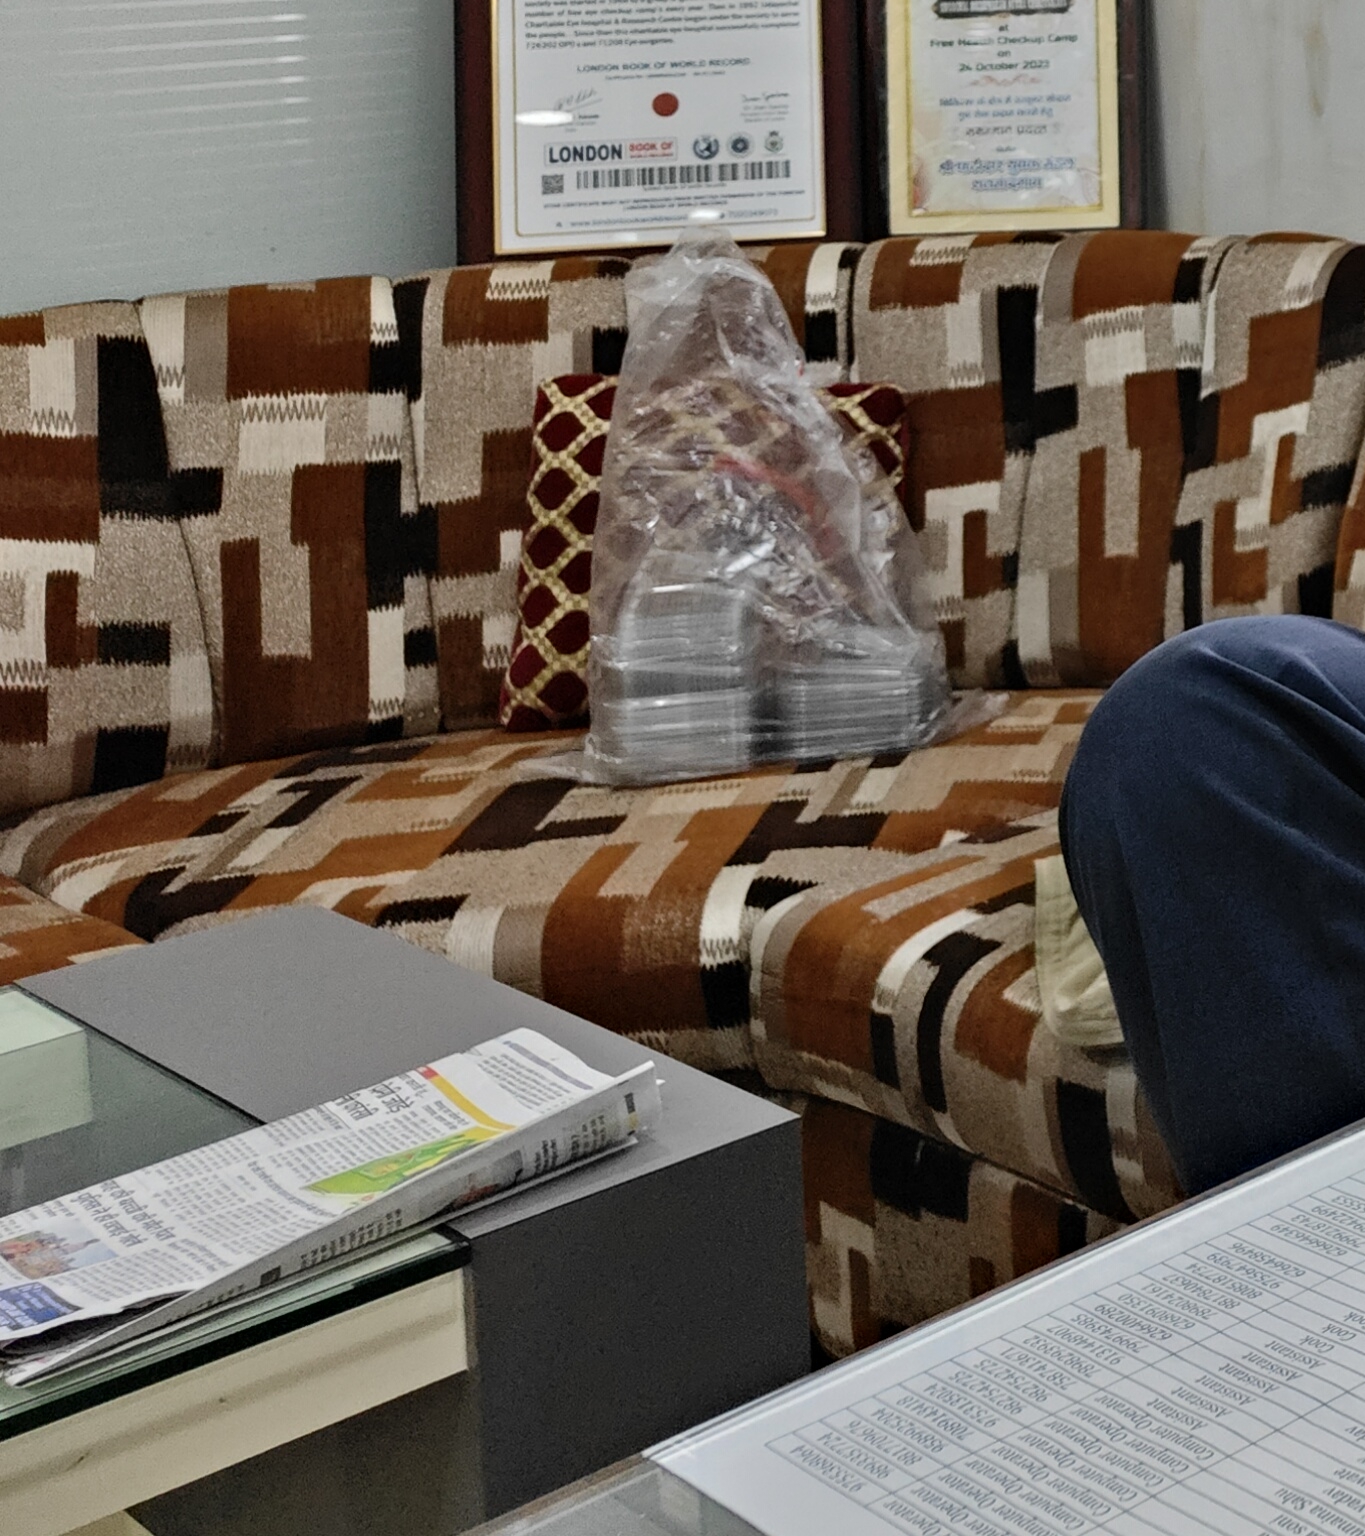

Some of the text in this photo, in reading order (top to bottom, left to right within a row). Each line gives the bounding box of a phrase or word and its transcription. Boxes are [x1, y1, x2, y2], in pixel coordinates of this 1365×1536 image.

[577, 63, 620, 73] LONDON
[623, 62, 651, 71] BOOK
[549, 144, 623, 164] LONDON
[1295, 1334, 1336, 1354] Cook
[1238, 1350, 1304, 1383] Assistant
[1091, 1392, 1161, 1430] Operator
[1142, 1397, 1209, 1432] Assistant
[1166, 1384, 1234, 1420] Assistant
[1146, 1422, 1221, 1462] Computer
[960, 1457, 1029, 1496] Operator
[988, 1443, 1057, 1482] Operator
[1096, 1449, 1171, 1489] Computer
[1042, 1475, 1120, 1518] Computer
